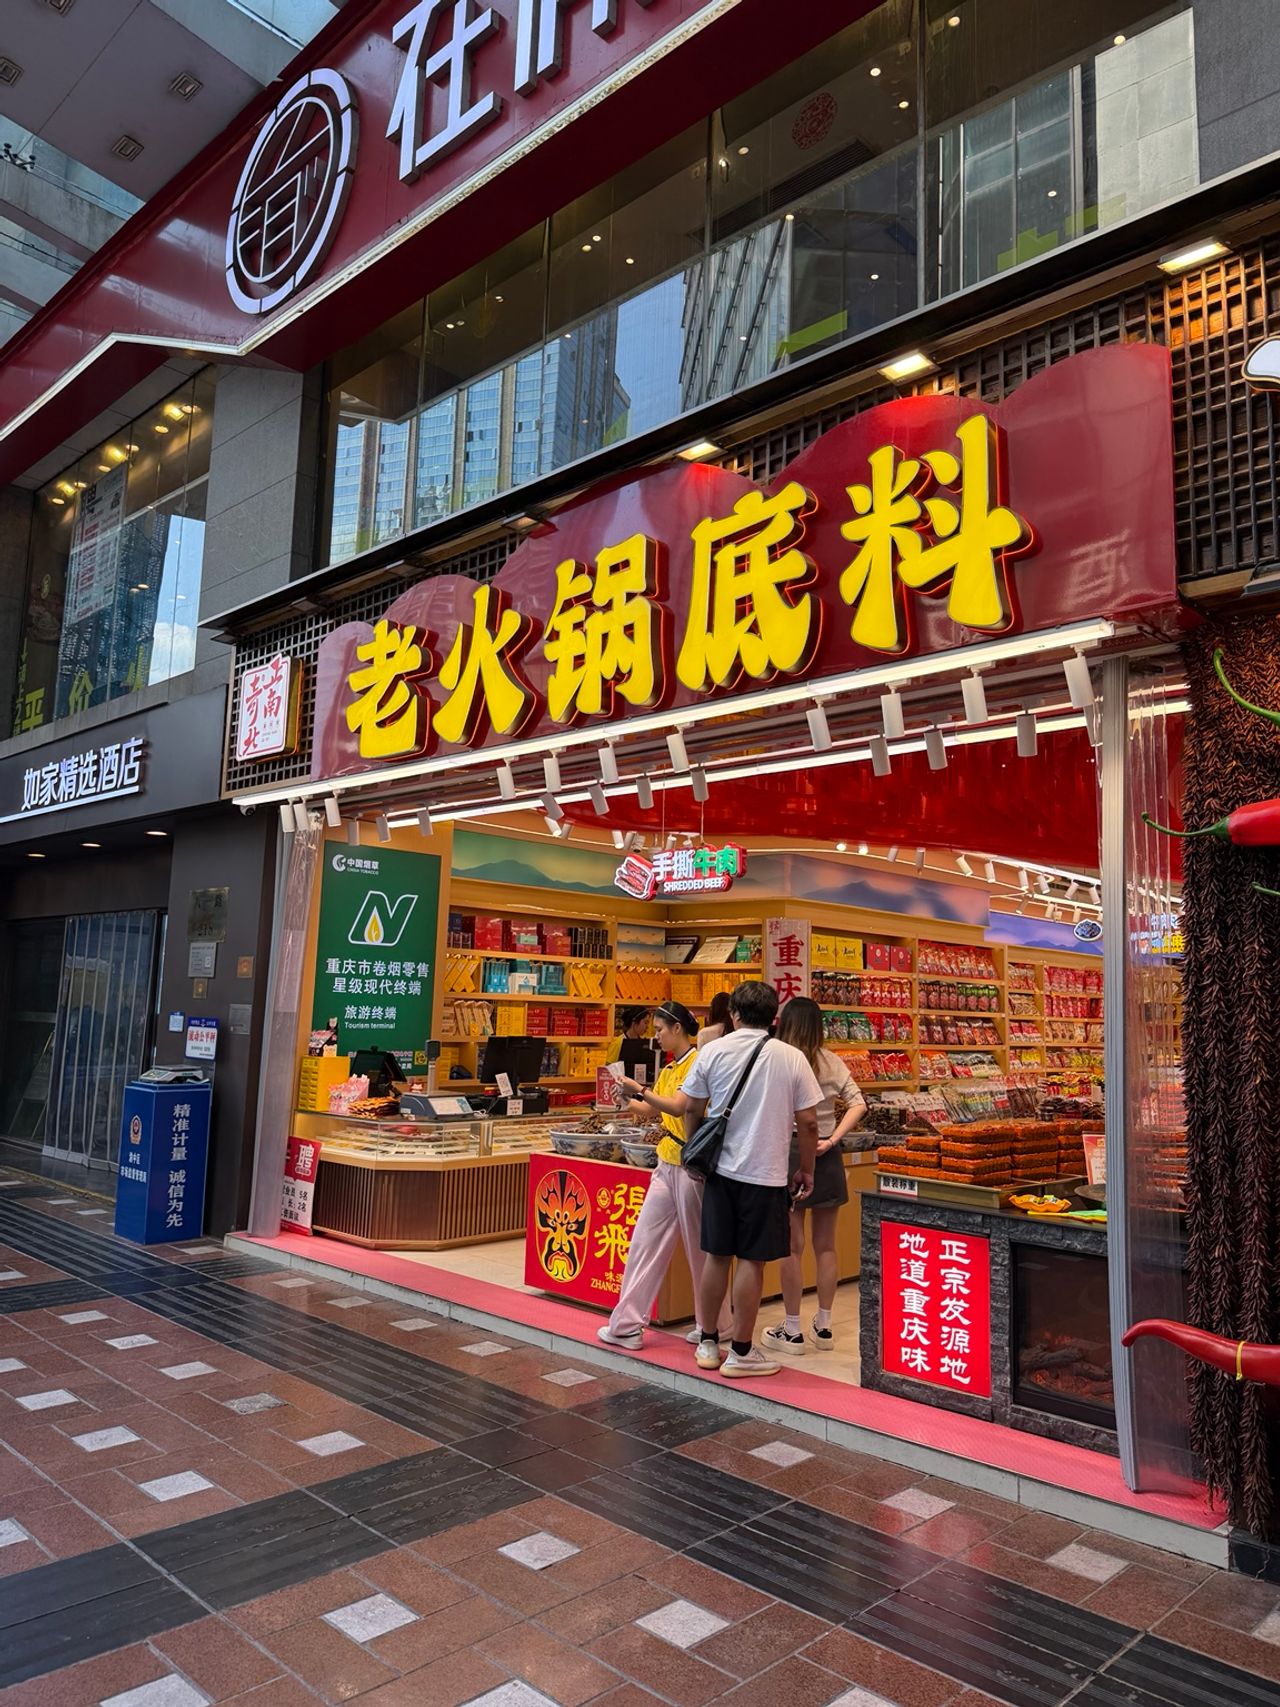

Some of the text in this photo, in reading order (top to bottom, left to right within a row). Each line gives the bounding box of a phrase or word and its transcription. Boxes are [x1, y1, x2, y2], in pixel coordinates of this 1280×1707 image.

[346, 414, 1022, 760] 老火锅底料
[21, 736, 144, 811] 如家精选酒店
[346, 858, 379, 870] 中国烟草
[651, 845, 738, 881] 手撕牛肉
[663, 876, 724, 892] SHREDDED BEEF
[325, 958, 430, 978] 重庆市卷烟零售
[332, 977, 422, 996] 星级现代终端
[344, 1005, 397, 1021] 旅游终端
[370, 1022, 396, 1030] terminal
[166, 1103, 191, 1229] 精准计量 诚信为先
[899, 1231, 932, 1373] 地道重庆味
[938, 1239, 972, 1385] 正宗发源地
